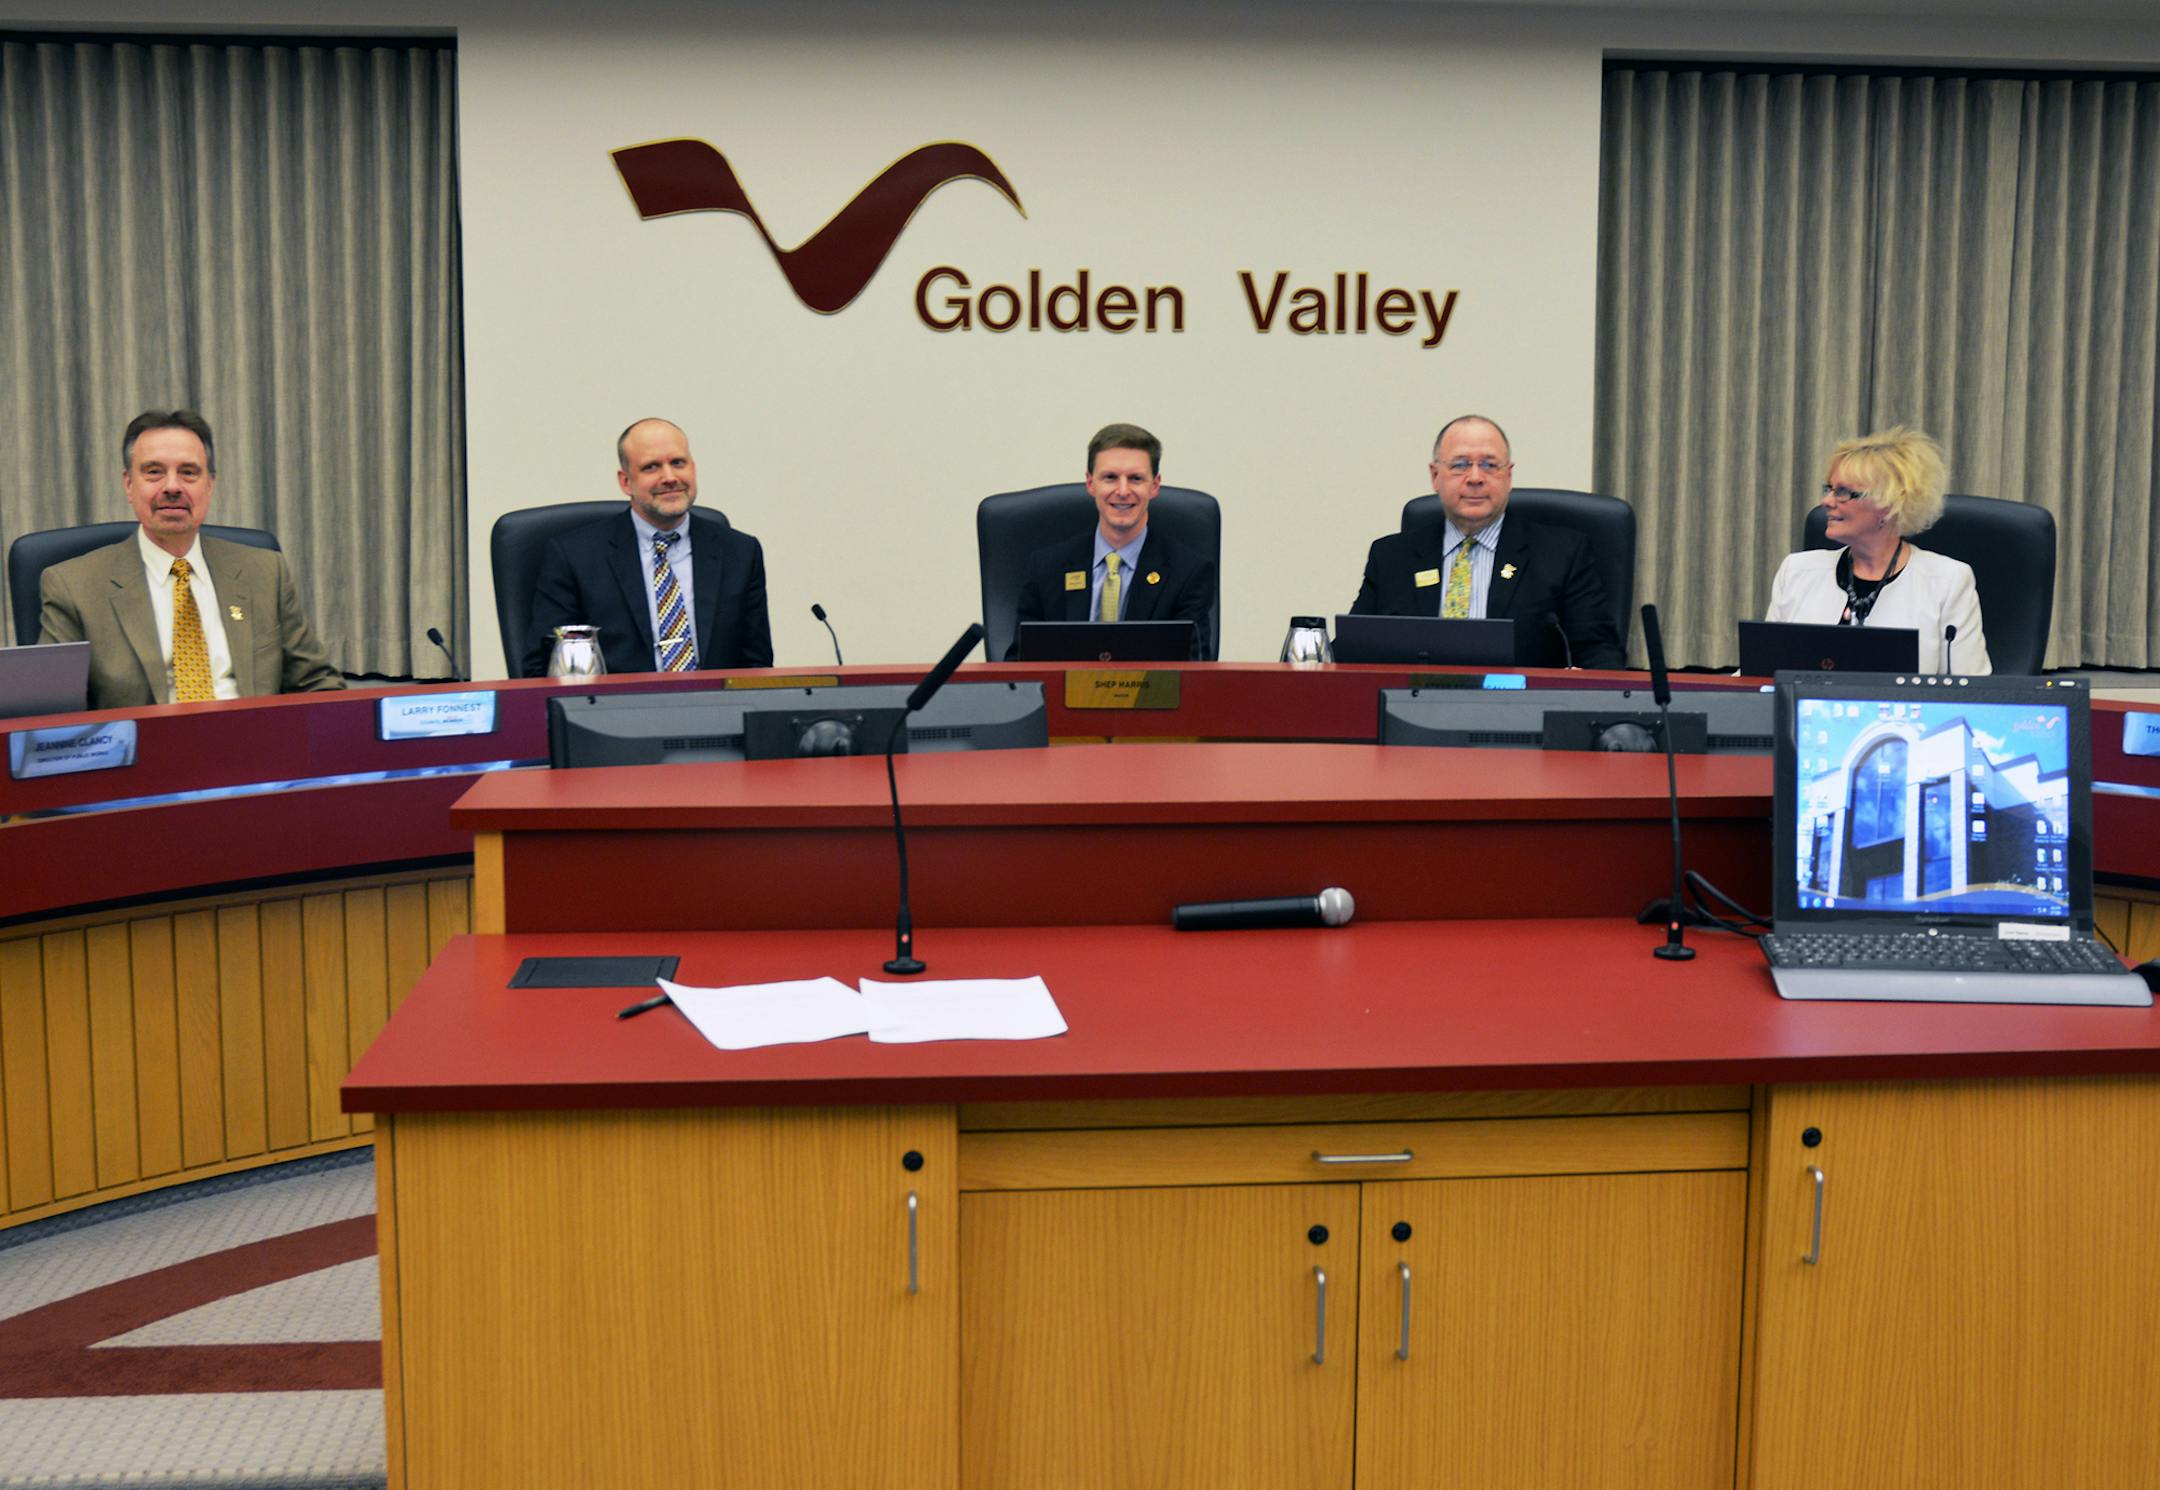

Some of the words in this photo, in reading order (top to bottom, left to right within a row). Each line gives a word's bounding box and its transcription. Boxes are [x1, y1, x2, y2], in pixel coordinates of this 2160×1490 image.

[914, 265, 1186, 333] Golden
[1237, 269, 1461, 349] Valley
[401, 705, 434, 716] LARRY
[437, 703, 481, 713] FONNEST
[2145, 725, 2160, 735] TH
